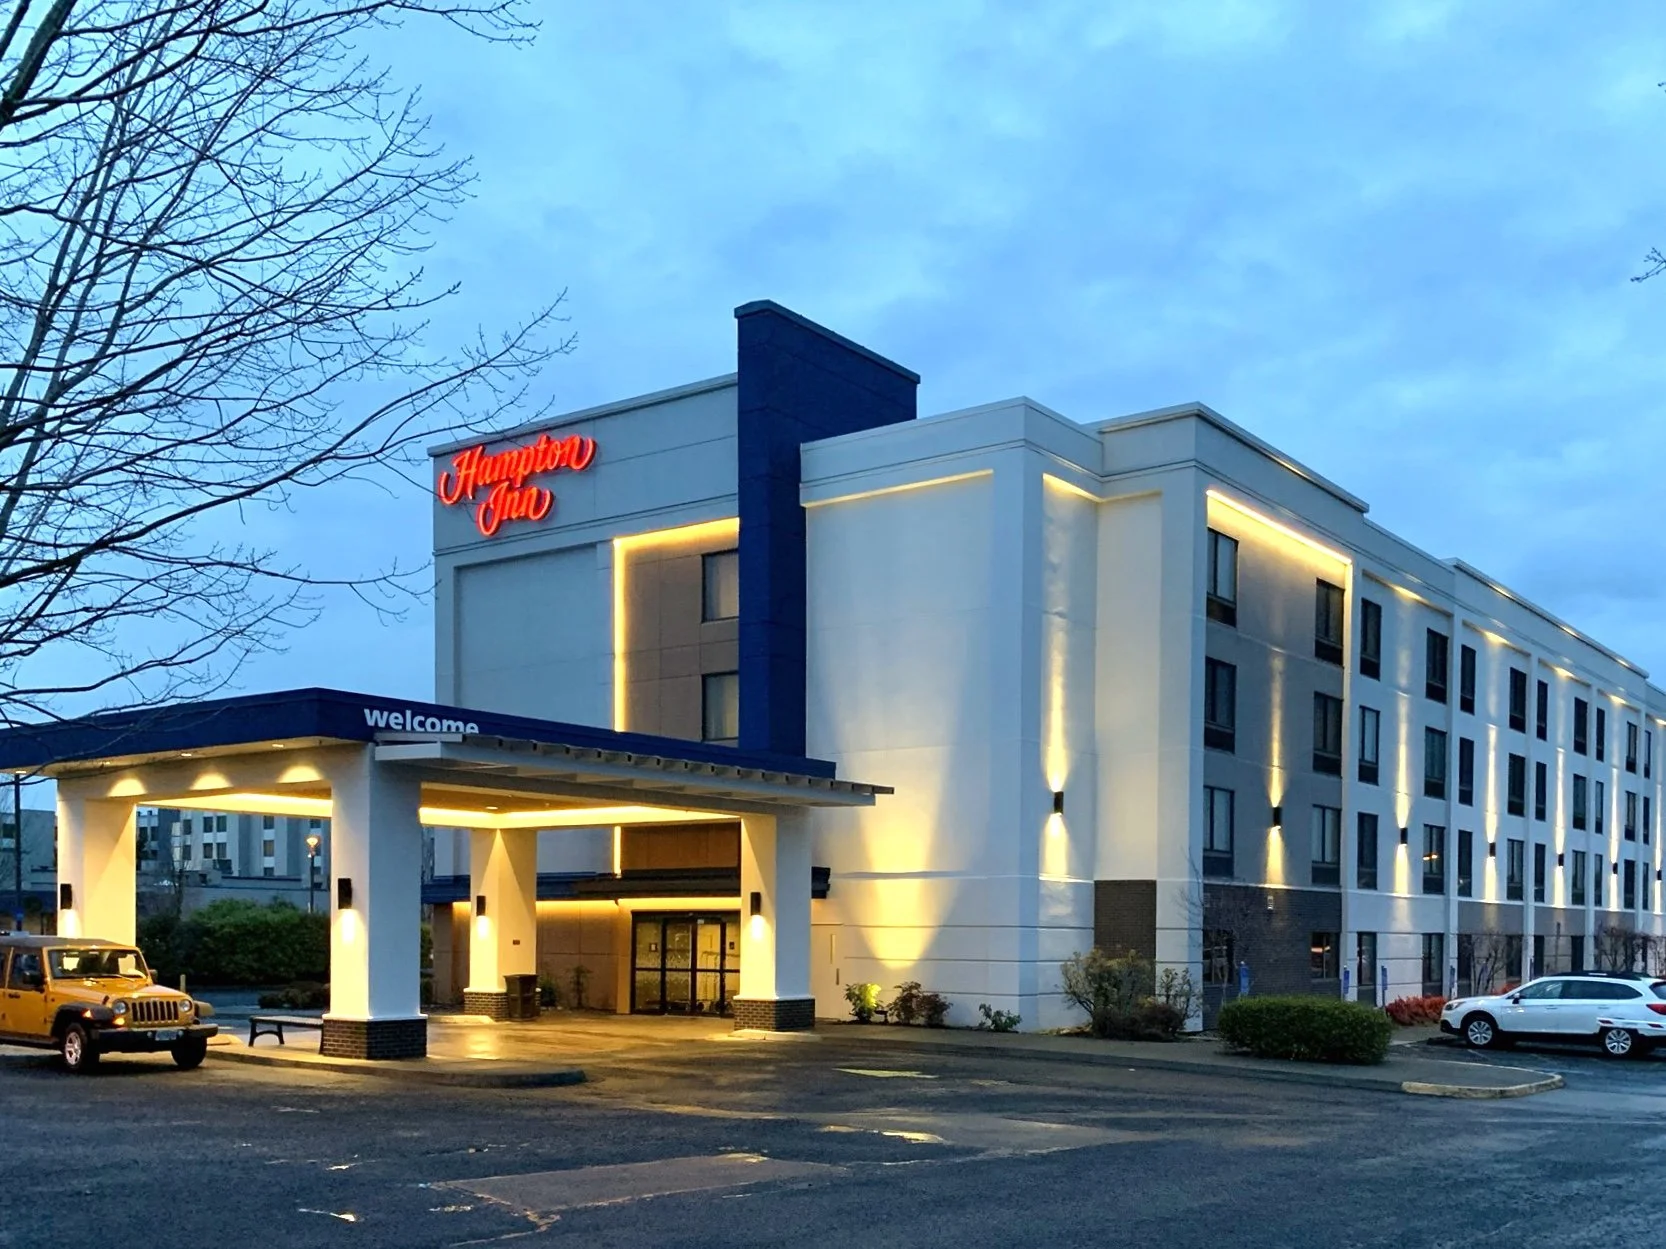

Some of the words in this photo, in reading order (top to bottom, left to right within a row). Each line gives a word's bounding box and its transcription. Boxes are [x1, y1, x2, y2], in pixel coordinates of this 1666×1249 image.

[438, 433, 597, 505] Hampton
[476, 480, 554, 537] Inn
[364, 708, 479, 734] welcome
